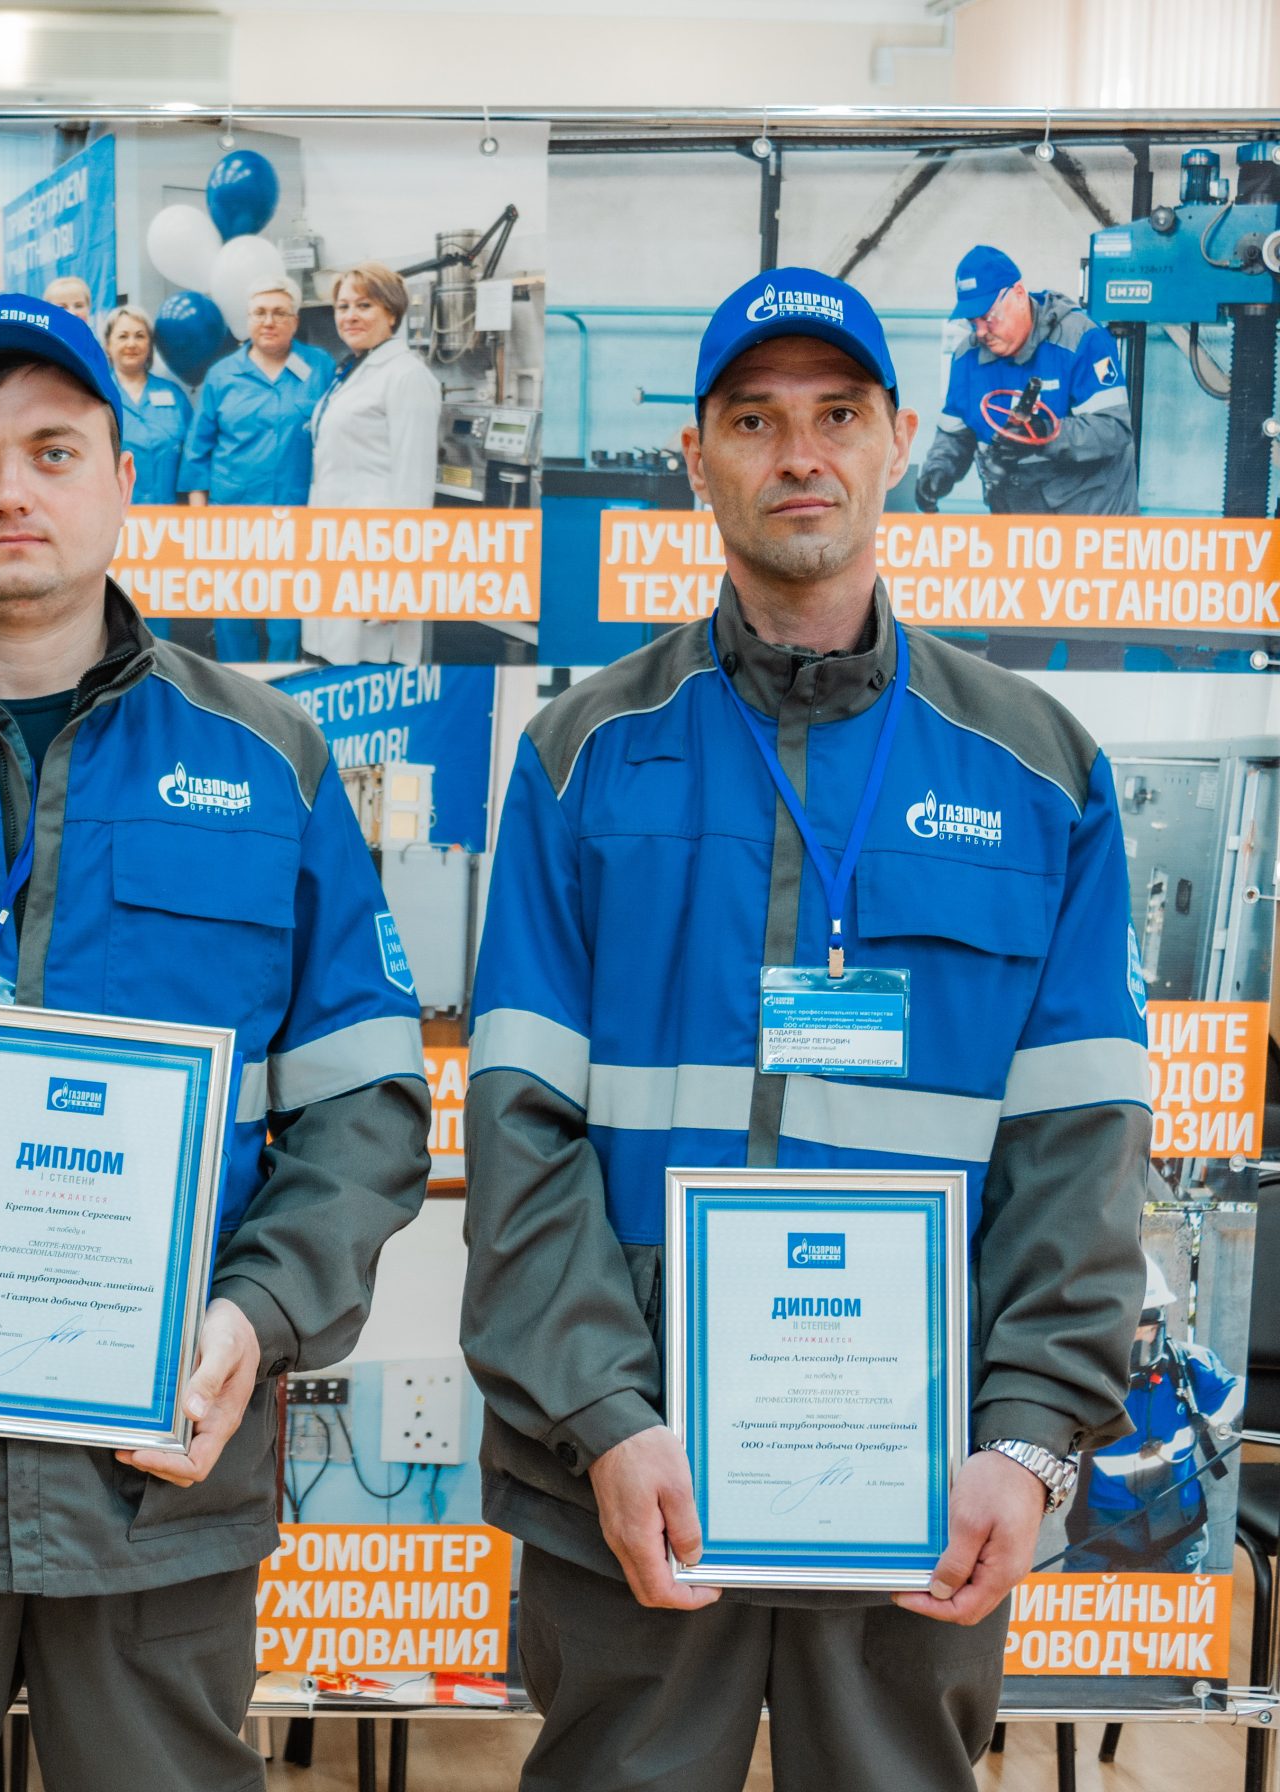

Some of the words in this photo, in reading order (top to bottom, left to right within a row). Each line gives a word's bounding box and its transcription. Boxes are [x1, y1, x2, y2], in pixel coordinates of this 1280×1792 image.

[778, 291, 843, 311] ГАЗПРОМ
[780, 304, 842, 319] ДОБЫЧА
[113, 509, 296, 561] ЛУЧШИЙ
[306, 518, 534, 564] ЛАБОРАНТ
[1007, 526, 1062, 570] ПО
[1075, 527, 1272, 573] РЕМОНТУ
[331, 570, 532, 615] АНАЛИЗА
[883, 576, 1025, 620] ЕСКИХ
[1037, 578, 1279, 624] УСТАНОВОК
[333, 726, 409, 768] ИКОВ!
[188, 777, 250, 799] ГАЗПРОМ
[190, 804, 251, 816] ОРЕНБУРГ
[191, 794, 249, 808] ДОБЫЧА
[939, 804, 1002, 829] ГАЗПРОМ
[941, 823, 1001, 838] ДОБЫЧА
[938, 832, 1001, 848] ОРЕНБУРГ
[68, 1090, 103, 1102] ГАЗПРОМ
[1150, 1111, 1254, 1152] ОЗИИ
[15, 1142, 124, 1175] ДИПЛОМ
[49, 1173, 95, 1186] СТЕПЕНИ
[24, 1189, 108, 1203] НАГРАЖДАЕТСЯ
[4, 1202, 44, 1213] Кретов
[45, 1206, 80, 1217] Антон
[81, 1209, 132, 1222] Сергеевич
[28, 1240, 102, 1253] СМОТРЕ-КОНКУРСЕ
[808, 1245, 841, 1255] ГАЗПРОМ
[85, 1254, 133, 1265] МАСТЕРСТВА
[16, 1273, 102, 1288] трубопроводчик
[103, 1281, 155, 1293] линейный
[0, 1292, 49, 1304] «Газпром
[50, 1296, 88, 1308] добыча
[89, 1300, 143, 1314] Оренбург»
[771, 1297, 862, 1320] ДИПЛОМ
[801, 1321, 841, 1331] СТЕПЕНИ
[749, 1353, 790, 1363] Бодарев
[791, 1354, 844, 1364] Александр
[846, 1354, 898, 1364] Петрович
[731, 1420, 778, 1430] «Лучший
[779, 1421, 865, 1431] трубопроводчик
[741, 1441, 764, 1449] ООО
[765, 1441, 814, 1451] «Газпром
[815, 1441, 853, 1450] добыча
[855, 1442, 908, 1452] Оренбург»
[271, 1532, 490, 1572] РОМОНТЕР
